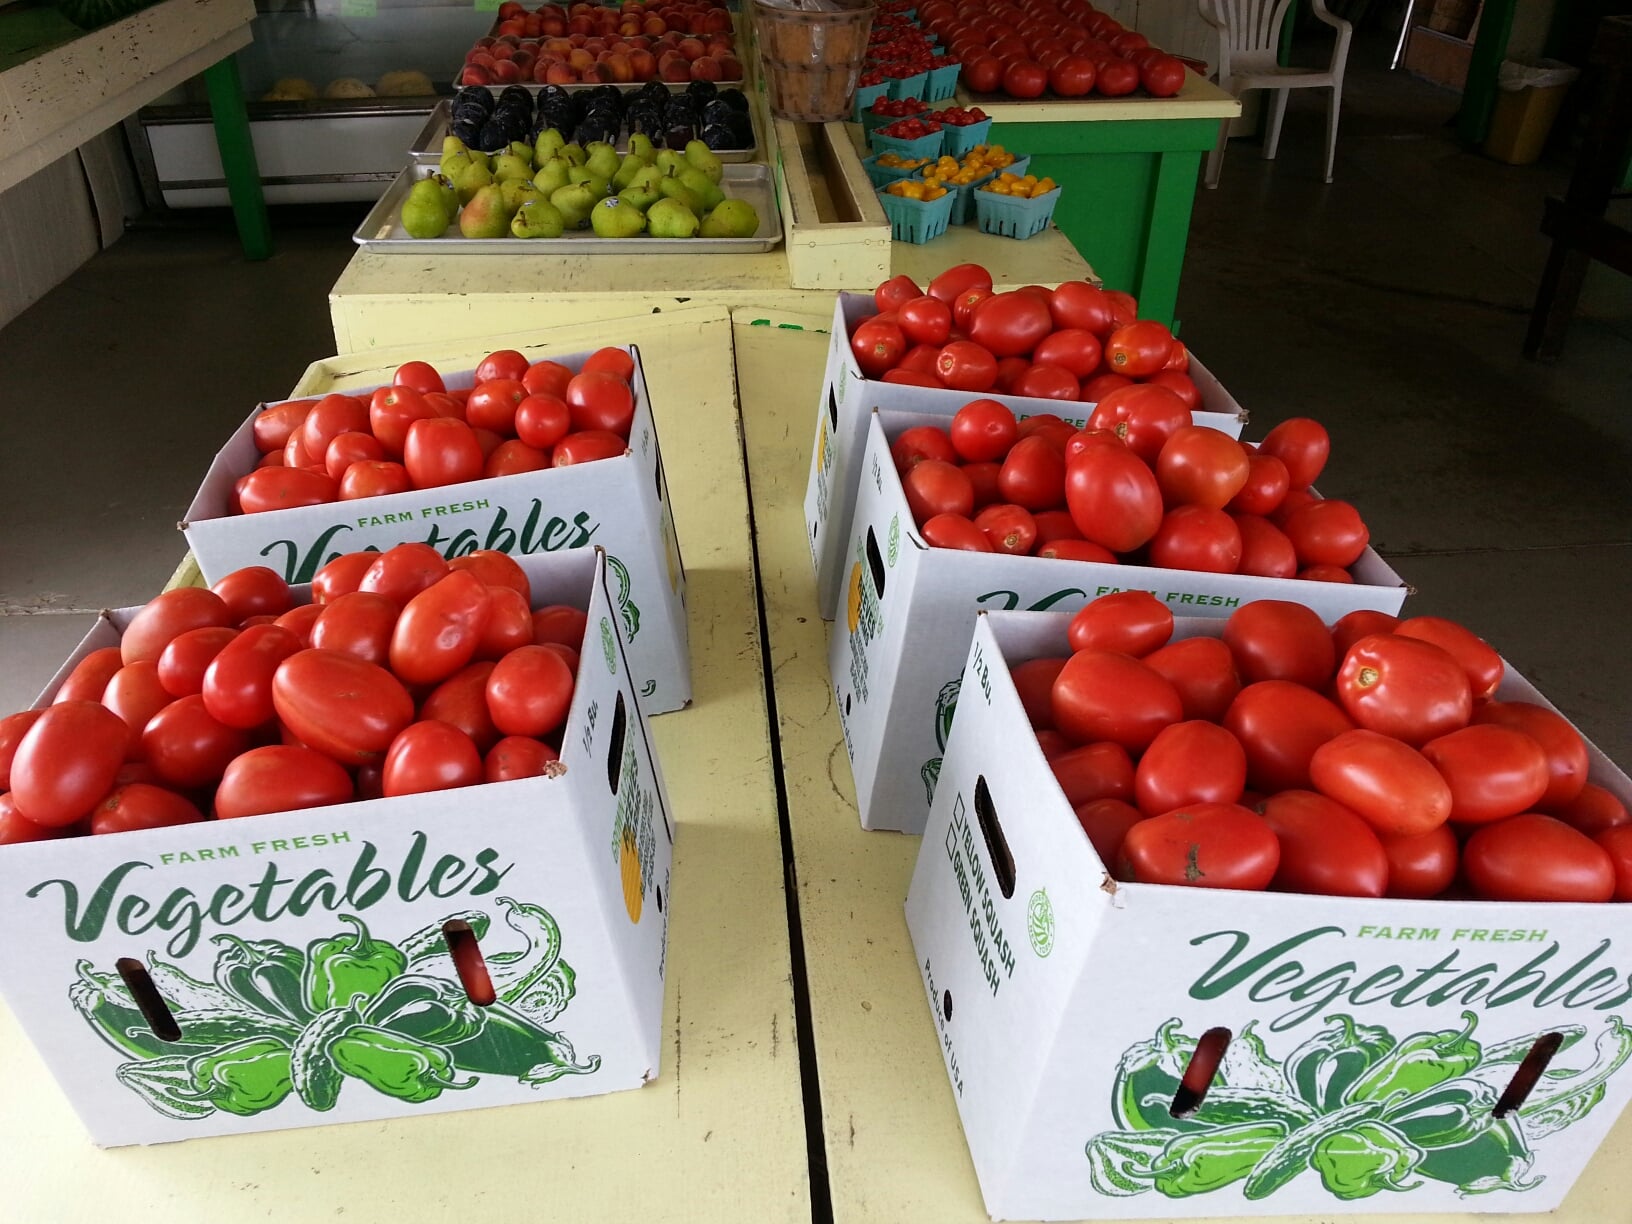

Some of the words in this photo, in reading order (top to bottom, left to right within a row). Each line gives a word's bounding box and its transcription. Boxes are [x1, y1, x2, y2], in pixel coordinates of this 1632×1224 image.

[357, 510, 414, 528] FARM
[423, 498, 491, 518] FRESH
[1165, 592, 1241, 608] FRESH
[973, 641, 982, 676] 1/2
[981, 664, 991, 706] Bu.
[160, 845, 240, 866] FARM
[253, 830, 352, 856] FRESH
[26, 830, 515, 958] Vegetables
[953, 850, 972, 915] GREEN
[970, 907, 1000, 997] SQUASH
[961, 817, 986, 894] YELLOW
[982, 887, 1016, 979] SQUASH
[1357, 925, 1441, 942] FARM
[1451, 928, 1550, 943] FRESH
[925, 957, 945, 1031] Produce
[944, 1033, 952, 1051] of
[950, 1052, 964, 1098] USA
